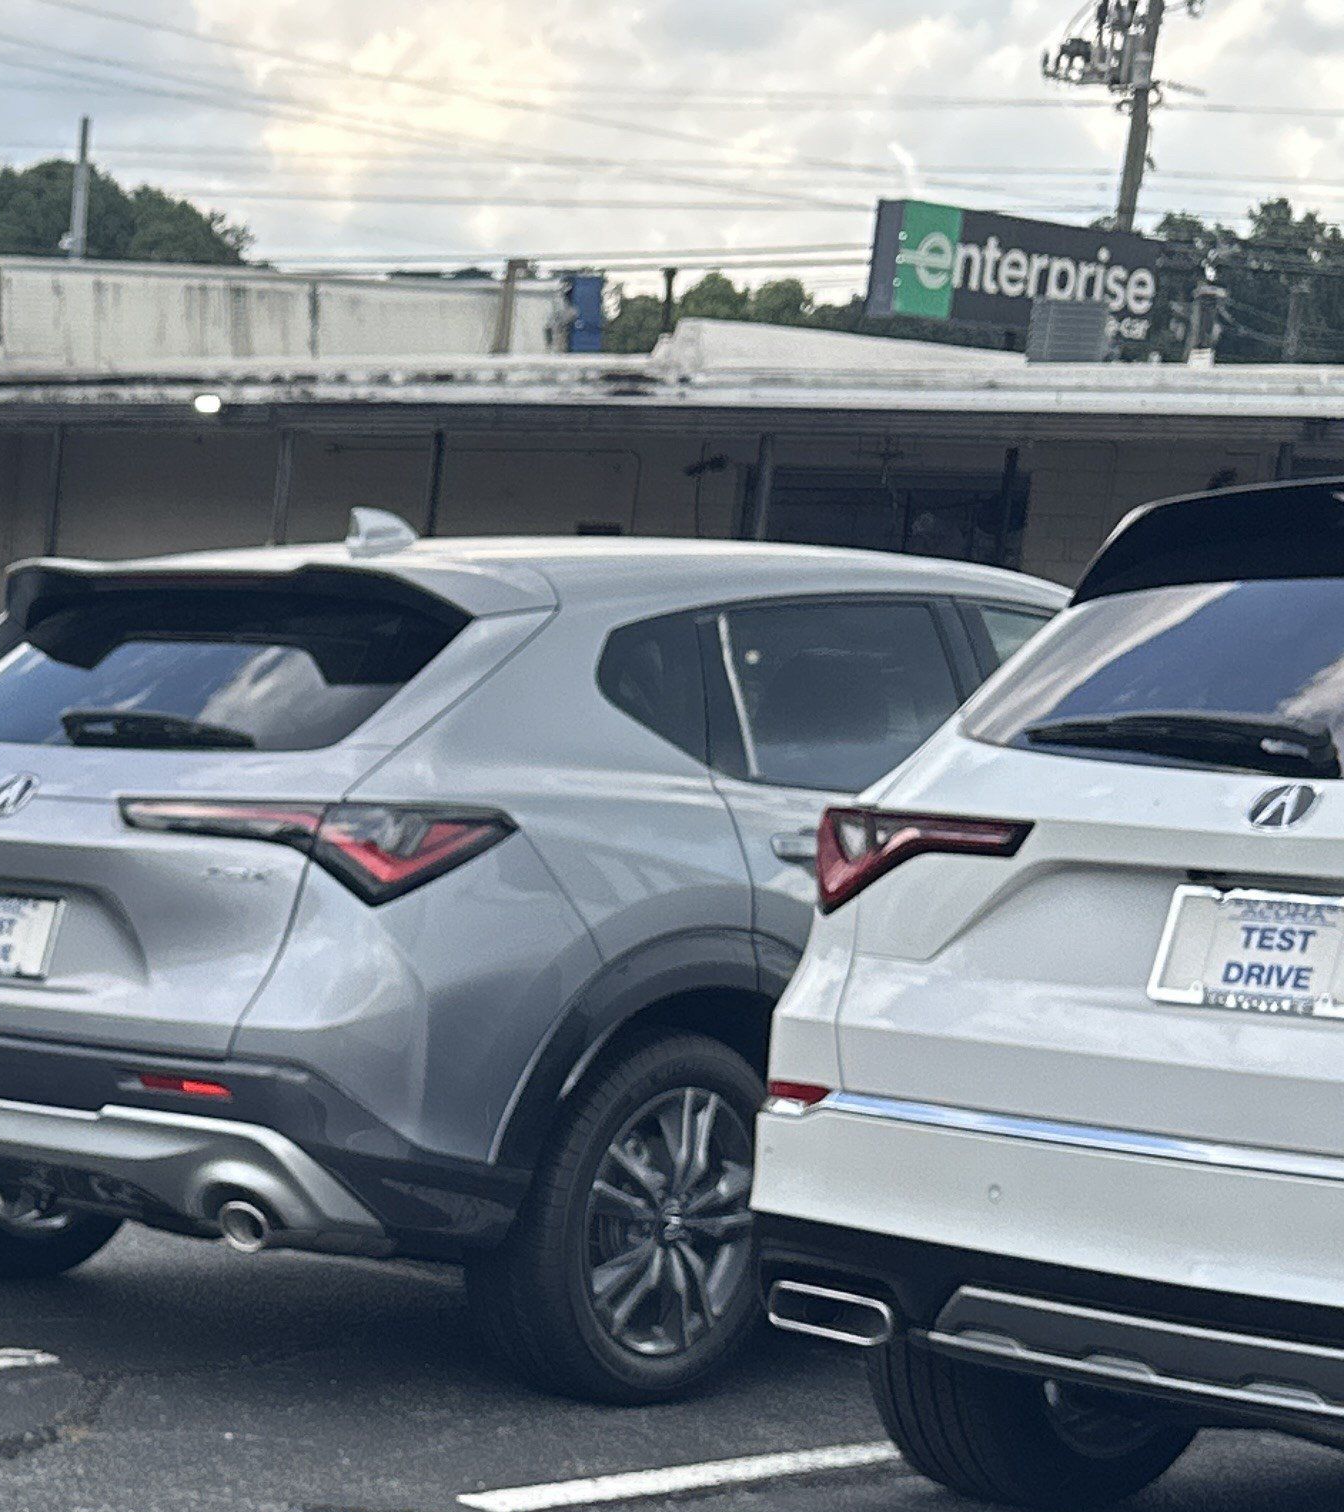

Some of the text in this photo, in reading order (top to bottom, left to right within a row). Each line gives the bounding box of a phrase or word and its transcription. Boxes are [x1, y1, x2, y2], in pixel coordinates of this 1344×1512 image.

[898, 231, 1155, 314] enterprise
[1240, 926, 1317, 953] TEST
[1221, 960, 1314, 989] DRIVE
